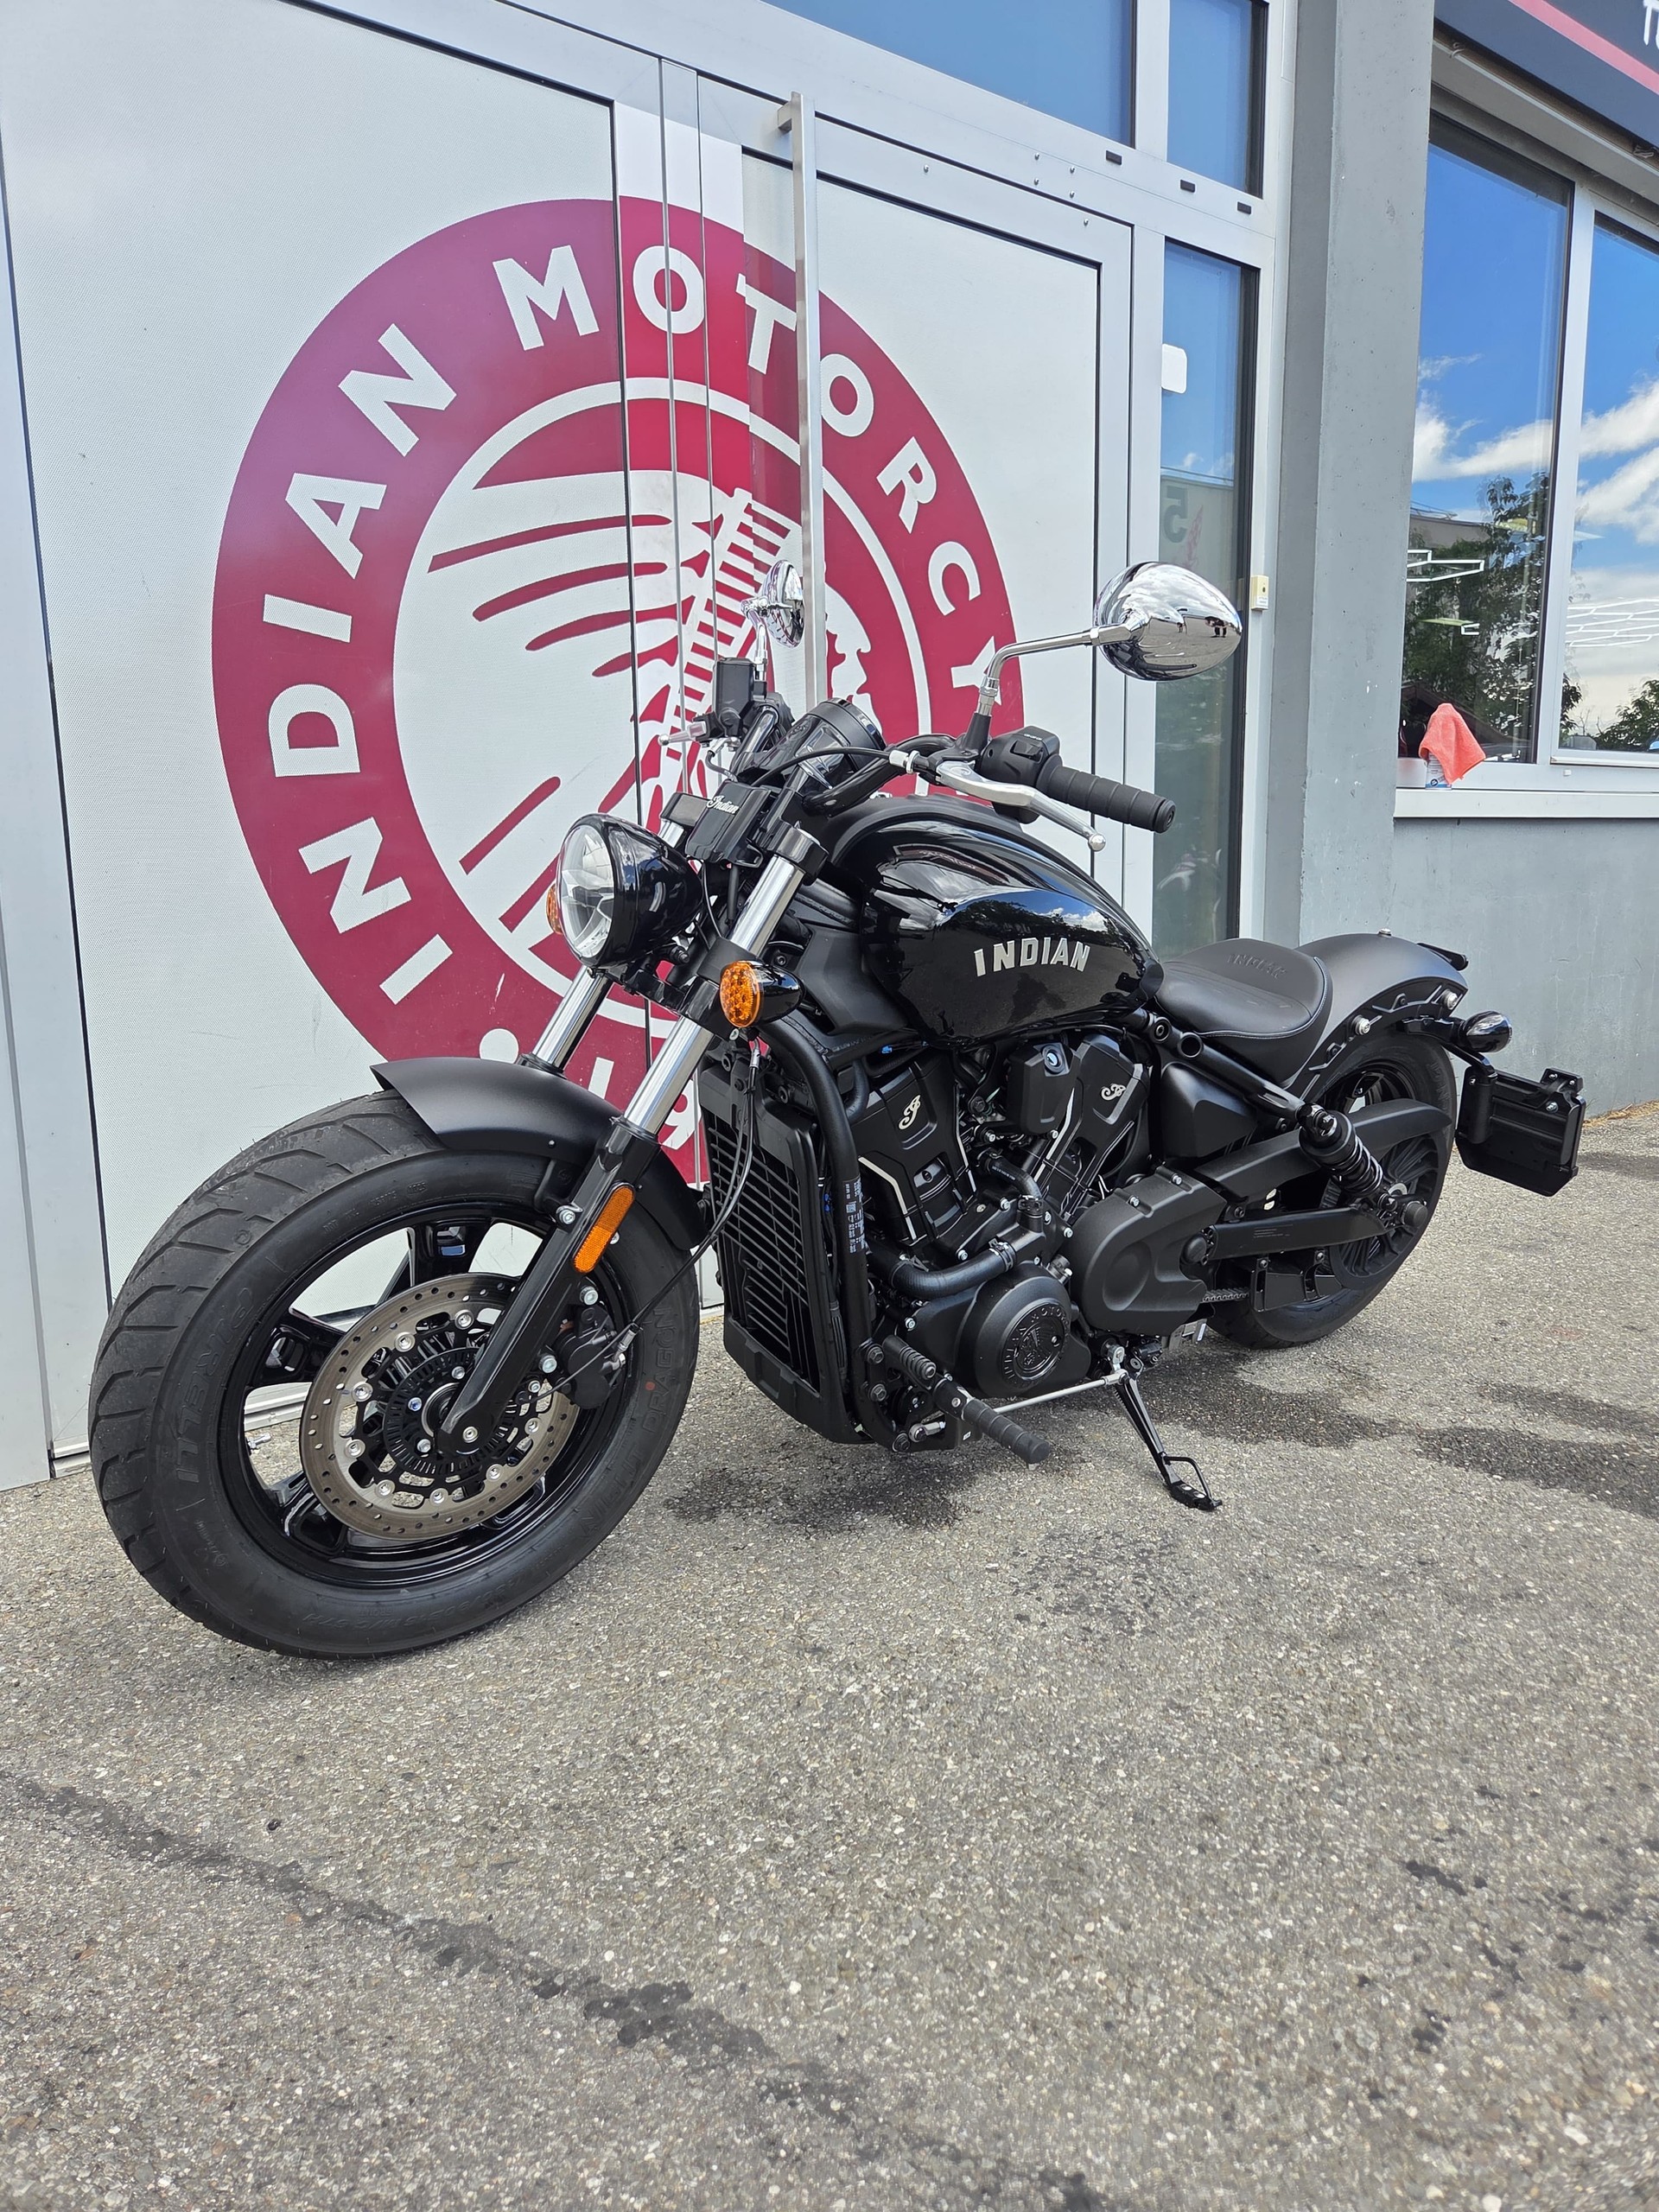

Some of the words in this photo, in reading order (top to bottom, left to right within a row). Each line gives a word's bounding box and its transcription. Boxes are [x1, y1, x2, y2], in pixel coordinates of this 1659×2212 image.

[263, 322, 457, 1005] INDIAN
[491, 245, 1002, 706] MOTORCY
[707, 795, 740, 815] Indian
[973, 937, 1091, 977] INDIAN
[175, 1287, 255, 1484] PIRELLI
[642, 1306, 677, 1434] DRAGON
